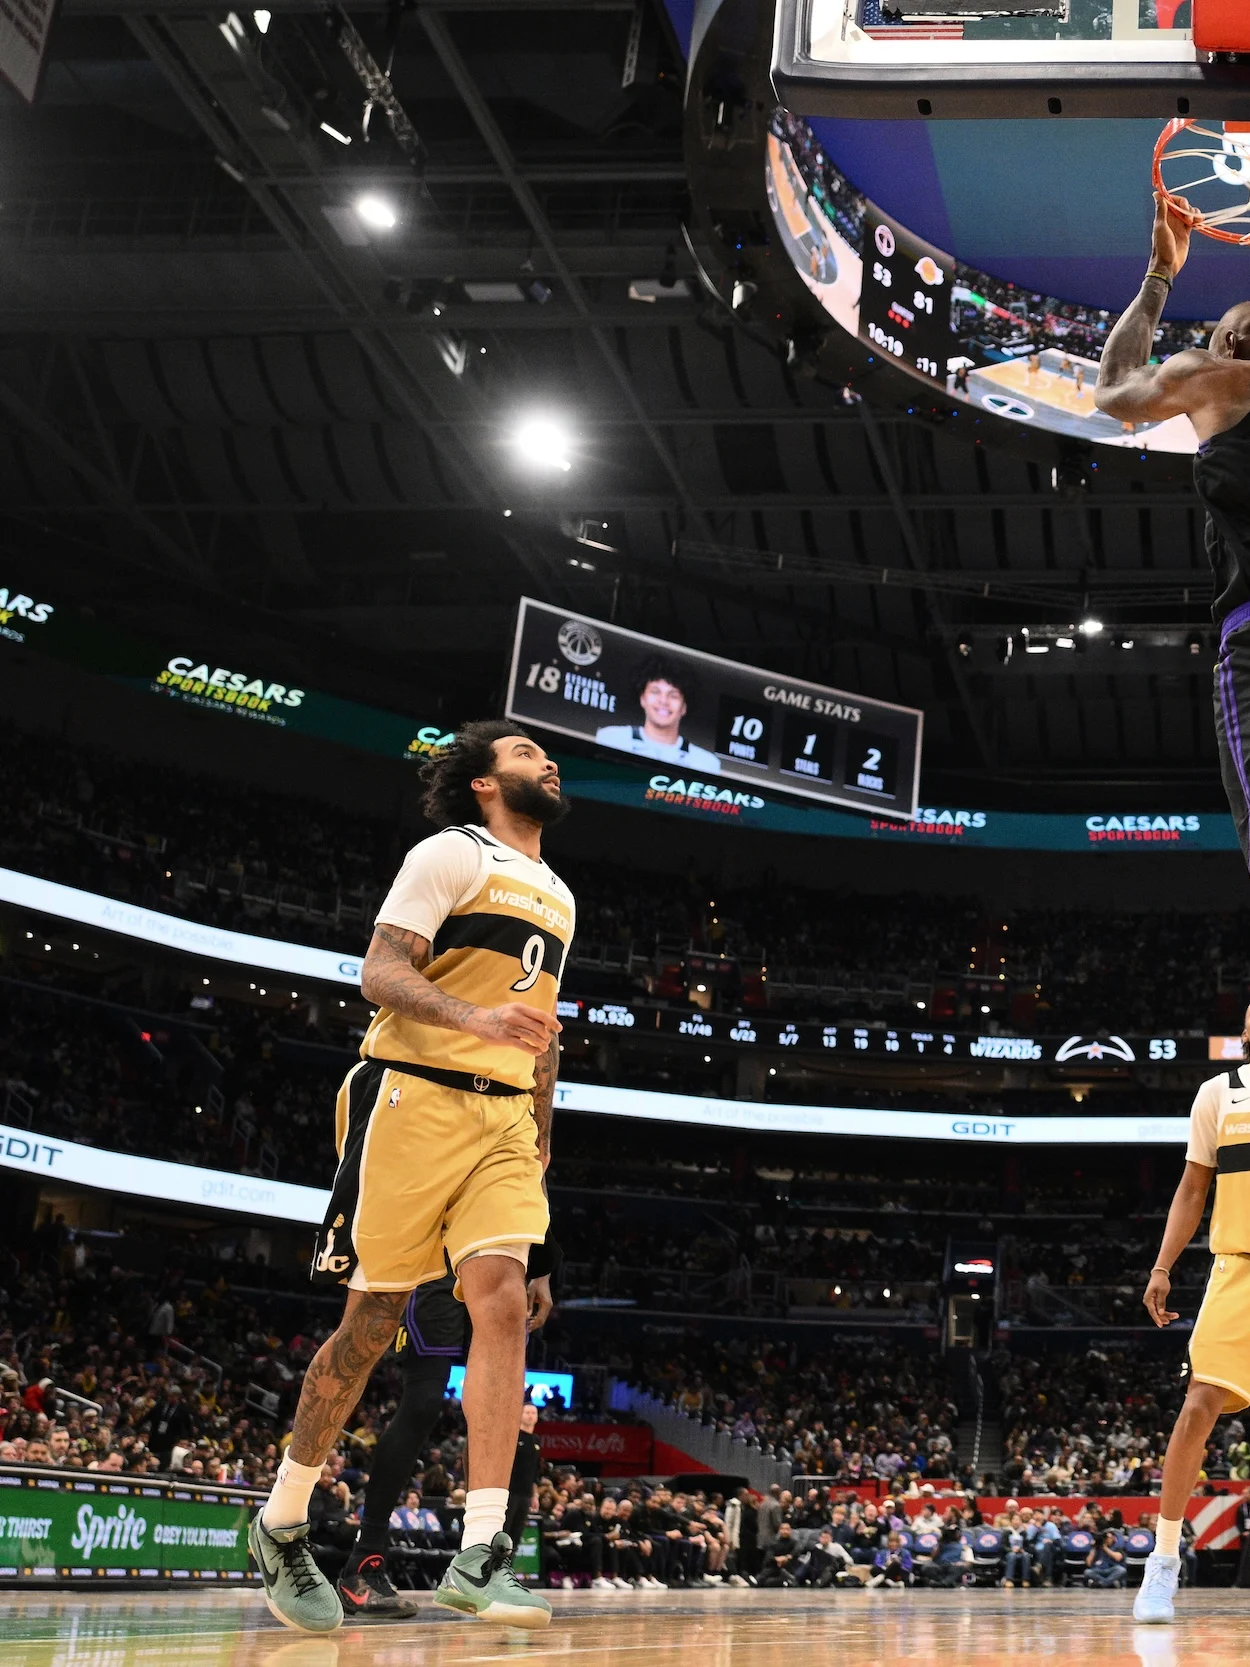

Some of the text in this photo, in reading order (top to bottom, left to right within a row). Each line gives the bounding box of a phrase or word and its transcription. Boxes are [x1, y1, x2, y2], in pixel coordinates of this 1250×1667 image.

[167, 656, 305, 707] CAESARS
[526, 662, 561, 693] 18
[156, 670, 272, 712] SPORTSBOOK
[763, 685, 862, 723] GAME STATS
[730, 715, 763, 741] 10
[802, 733, 817, 755] 1
[862, 748, 882, 771] 2
[645, 788, 741, 815] SPORTSBOOK
[649, 775, 765, 809] CAESARS
[915, 807, 987, 828] ESARS
[1085, 815, 1200, 832] CAESARS
[1088, 829, 1180, 841] SPORTSBOOK
[488, 887, 570, 933] washington
[509, 934, 546, 992] 9
[970, 1042, 1043, 1060] WIZARDS
[1149, 1039, 1177, 1060] 53
[951, 1121, 1017, 1137] GDIT
[0, 1135, 63, 1166] DIT
[200, 1178, 276, 1204] gdit.com
[7, 1516, 52, 1540] THIRST
[71, 1503, 147, 1560] Sprite
[153, 1523, 239, 1548] OBEY YOUR THIRST
